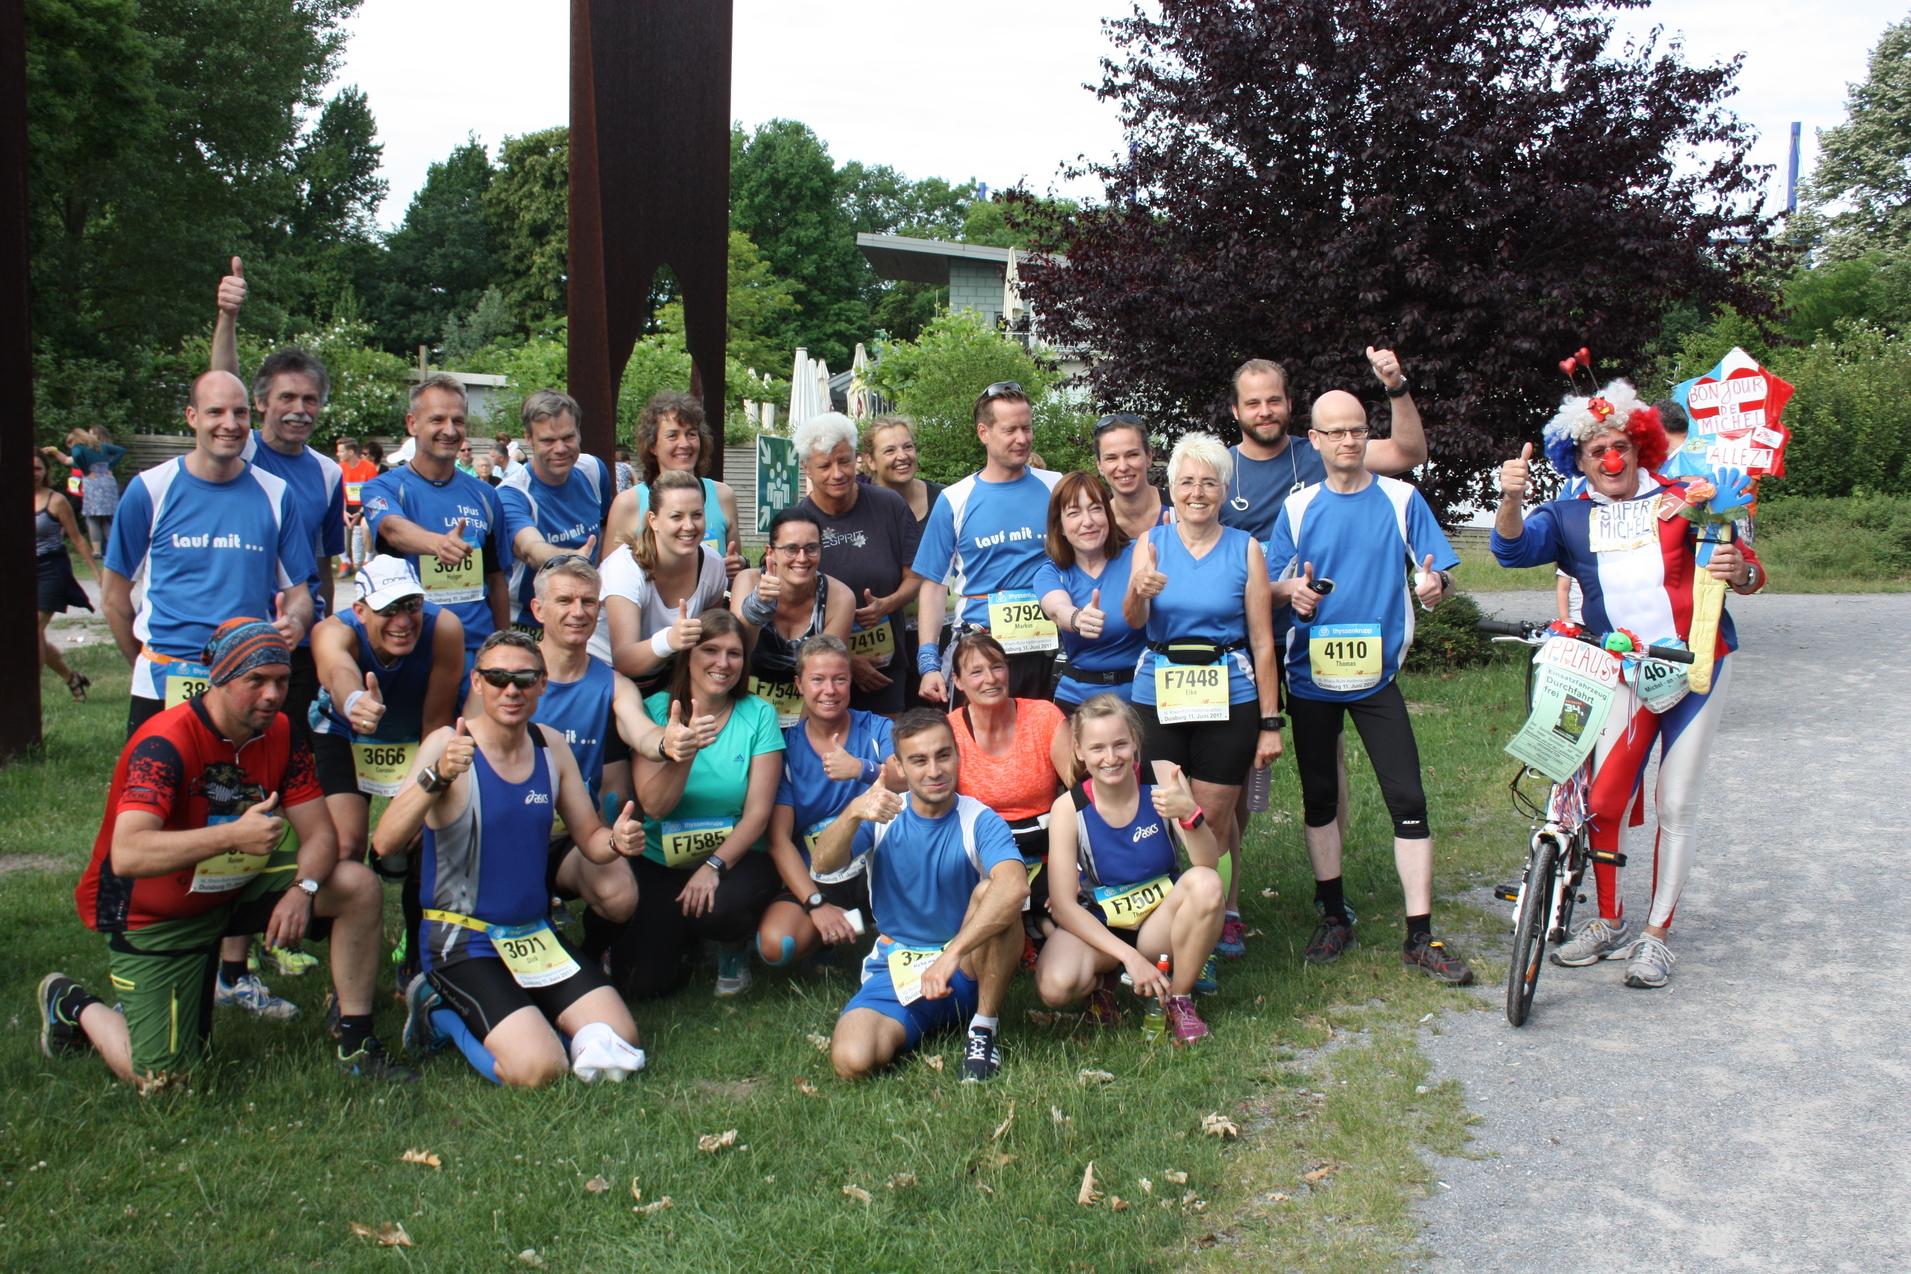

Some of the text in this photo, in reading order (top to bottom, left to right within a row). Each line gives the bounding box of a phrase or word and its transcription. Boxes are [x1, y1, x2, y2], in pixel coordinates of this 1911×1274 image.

[1719, 403, 1738, 416] DE
[1702, 411, 1765, 434] MICHEL
[1709, 447, 1772, 467] ALLEZ!
[1599, 499, 1651, 521] SUPER
[569, 523, 585, 538] mit
[1009, 527, 1032, 541] mit
[1599, 515, 1650, 539] MICHEL
[212, 533, 241, 549] mit
[1324, 641, 1367, 659] 4110
[1164, 669, 1219, 690] F7448
[756, 681, 802, 700] F7544
[1544, 685, 1560, 699] frei
[1546, 675, 1595, 705] Durchfahrt
[363, 747, 406, 766] 3666
[672, 830, 726, 855] F7585
[1111, 883, 1165, 915] F7501
[503, 937, 547, 959] 3671
